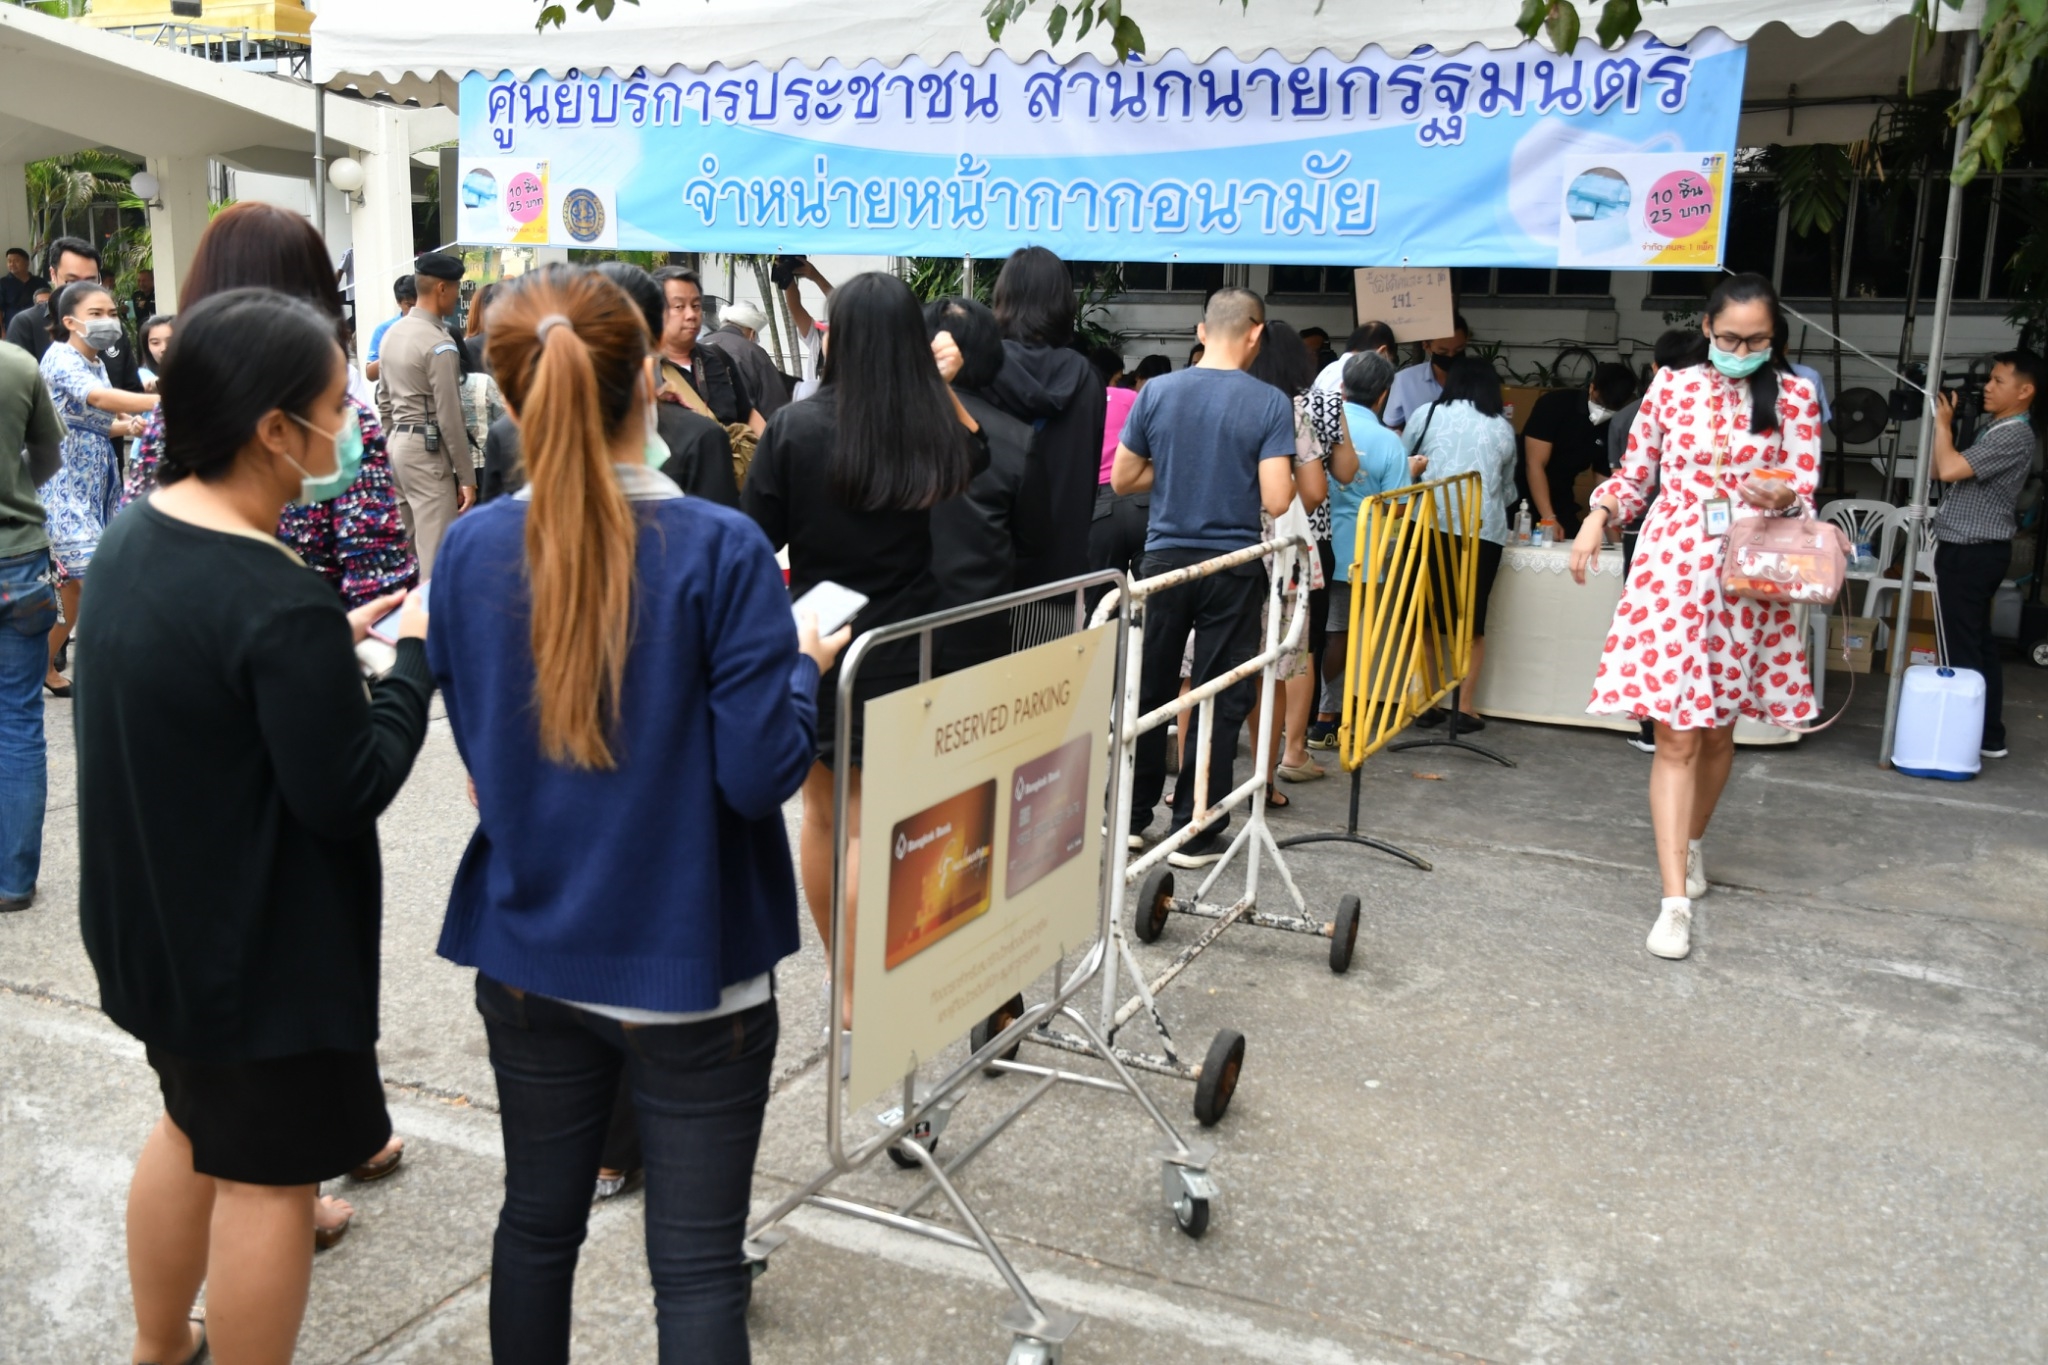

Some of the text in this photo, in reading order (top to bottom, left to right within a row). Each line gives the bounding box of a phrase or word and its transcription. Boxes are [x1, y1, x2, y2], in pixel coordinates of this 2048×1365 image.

[509, 187, 522, 198] 10
[689, 152, 1375, 233] จำหน่ายหน้ากากอนามัย
[1650, 177, 1704, 205] 10 ชิ้น
[509, 196, 544, 212] 25 บาท
[1649, 204, 1712, 224] 25 บาท
[935, 678, 1071, 758] RESERVED PARKING
